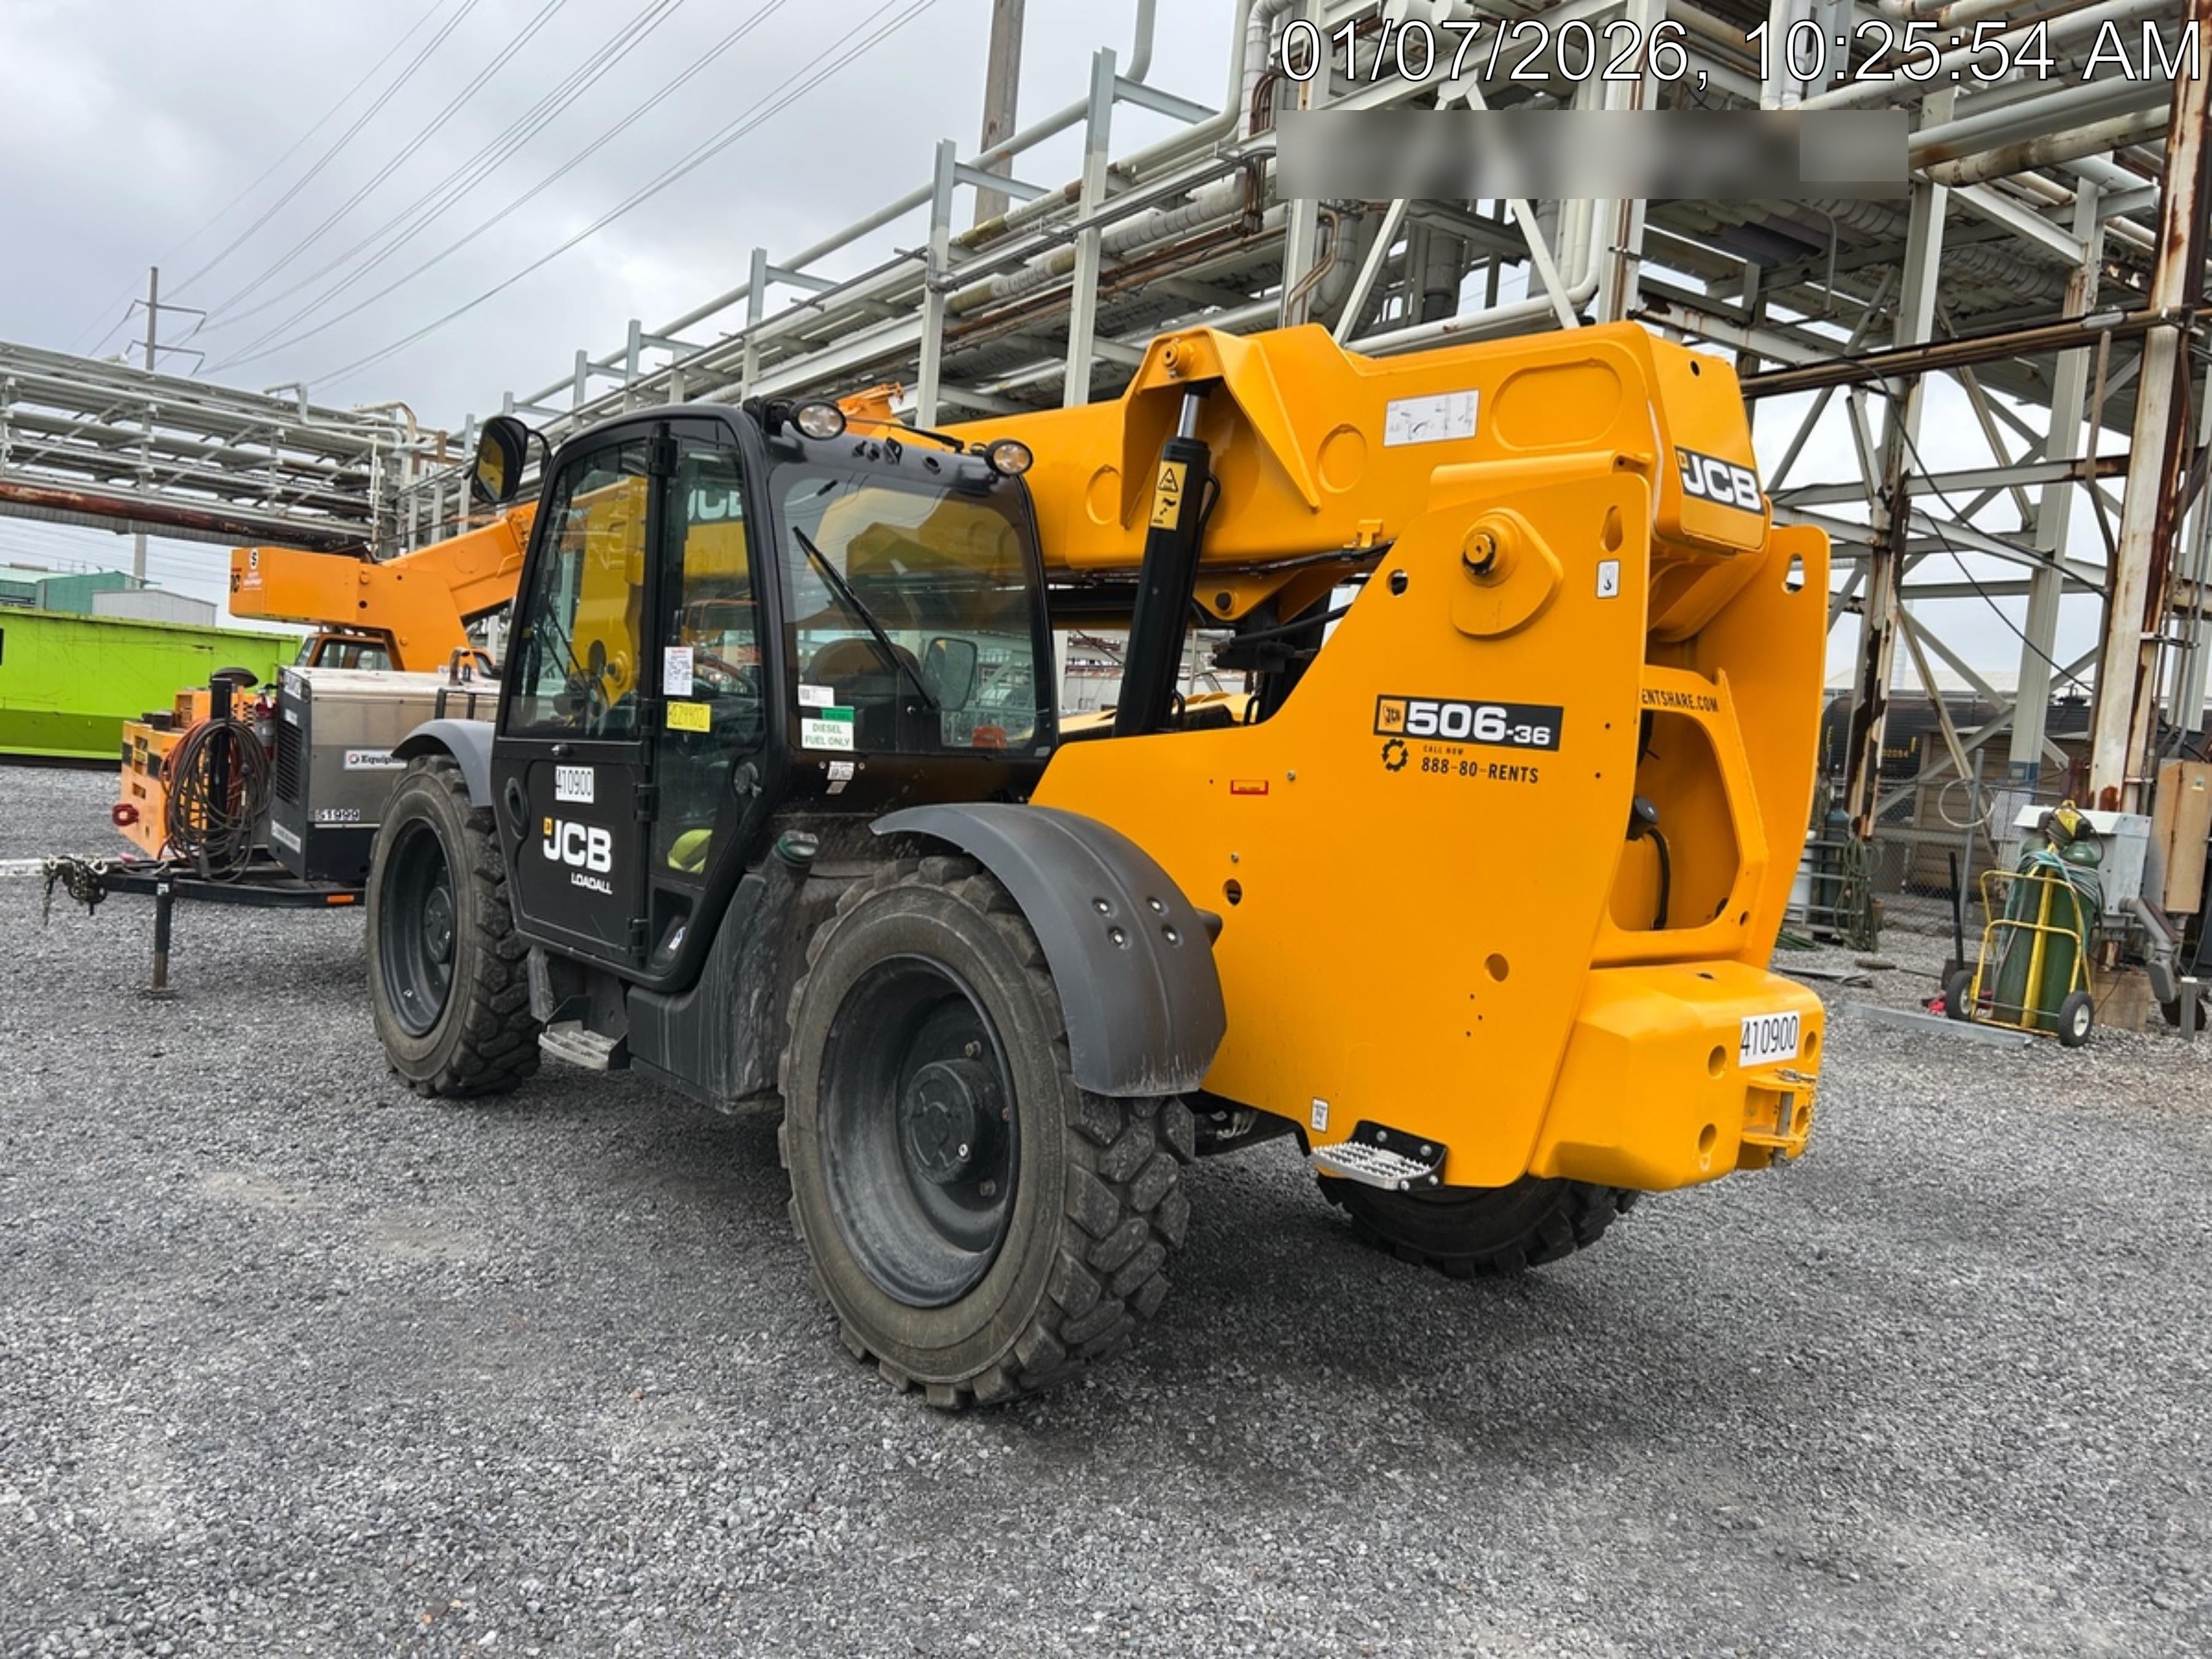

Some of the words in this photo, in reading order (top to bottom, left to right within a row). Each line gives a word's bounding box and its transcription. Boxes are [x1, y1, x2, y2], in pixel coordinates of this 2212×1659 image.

[1682, 454, 1762, 511] JCB
[812, 723, 843, 734] DIESEL
[1406, 701, 1551, 746] 506-36
[805, 735, 826, 745] FUEL
[828, 737, 850, 747] ONLY
[1422, 745, 1443, 755] CALL
[1421, 756, 1539, 784] 888-80-RENTS
[543, 819, 612, 873] JCB
[570, 871, 613, 895] LOADALL
[1740, 1015, 1798, 1057] 410900
